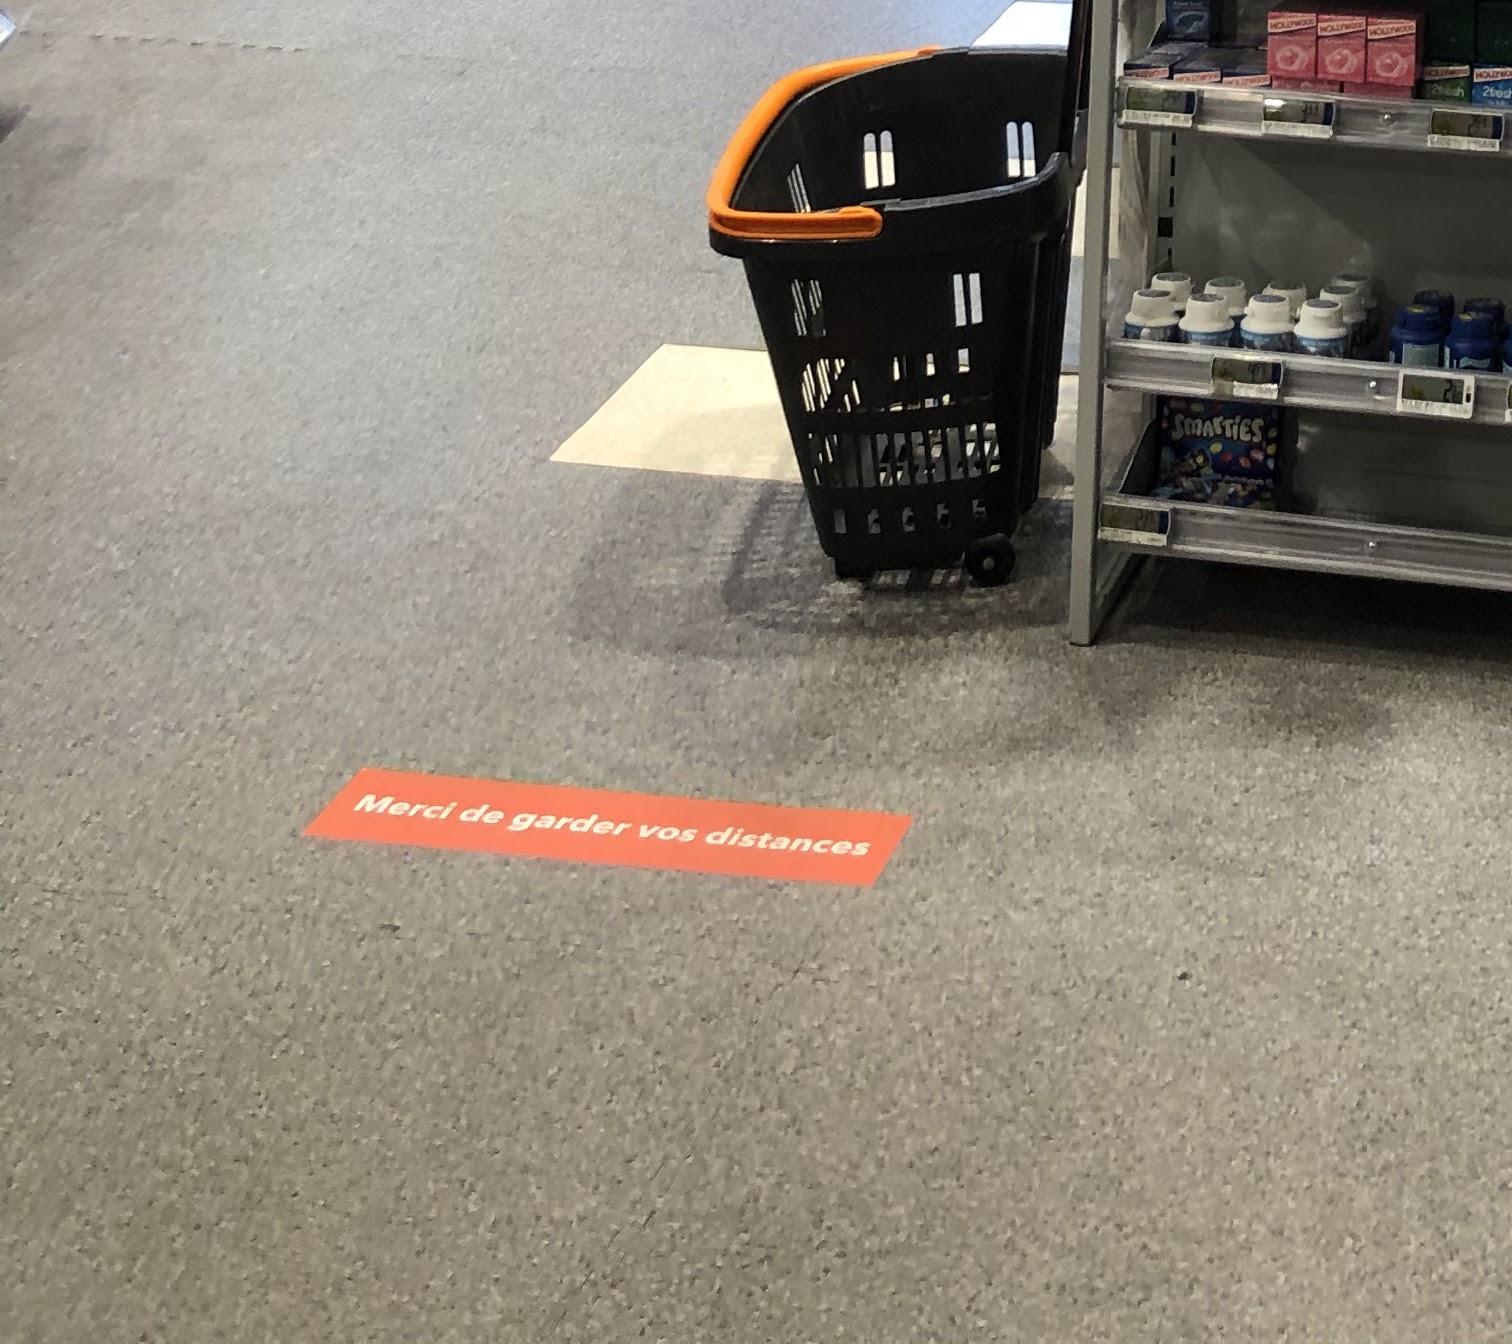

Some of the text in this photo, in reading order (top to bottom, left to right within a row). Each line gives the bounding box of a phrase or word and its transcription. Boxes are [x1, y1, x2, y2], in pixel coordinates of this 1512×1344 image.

[1270, 16, 1316, 30] HOLLYWOOD
[1319, 20, 1365, 34] HOLLYWOOD
[1369, 23, 1416, 38] HOLLYWOOD
[1431, 85, 1465, 99] 2fresh
[1171, 411, 1263, 443] SMARTIES
[353, 793, 871, 857] Merci de garder vos distances
